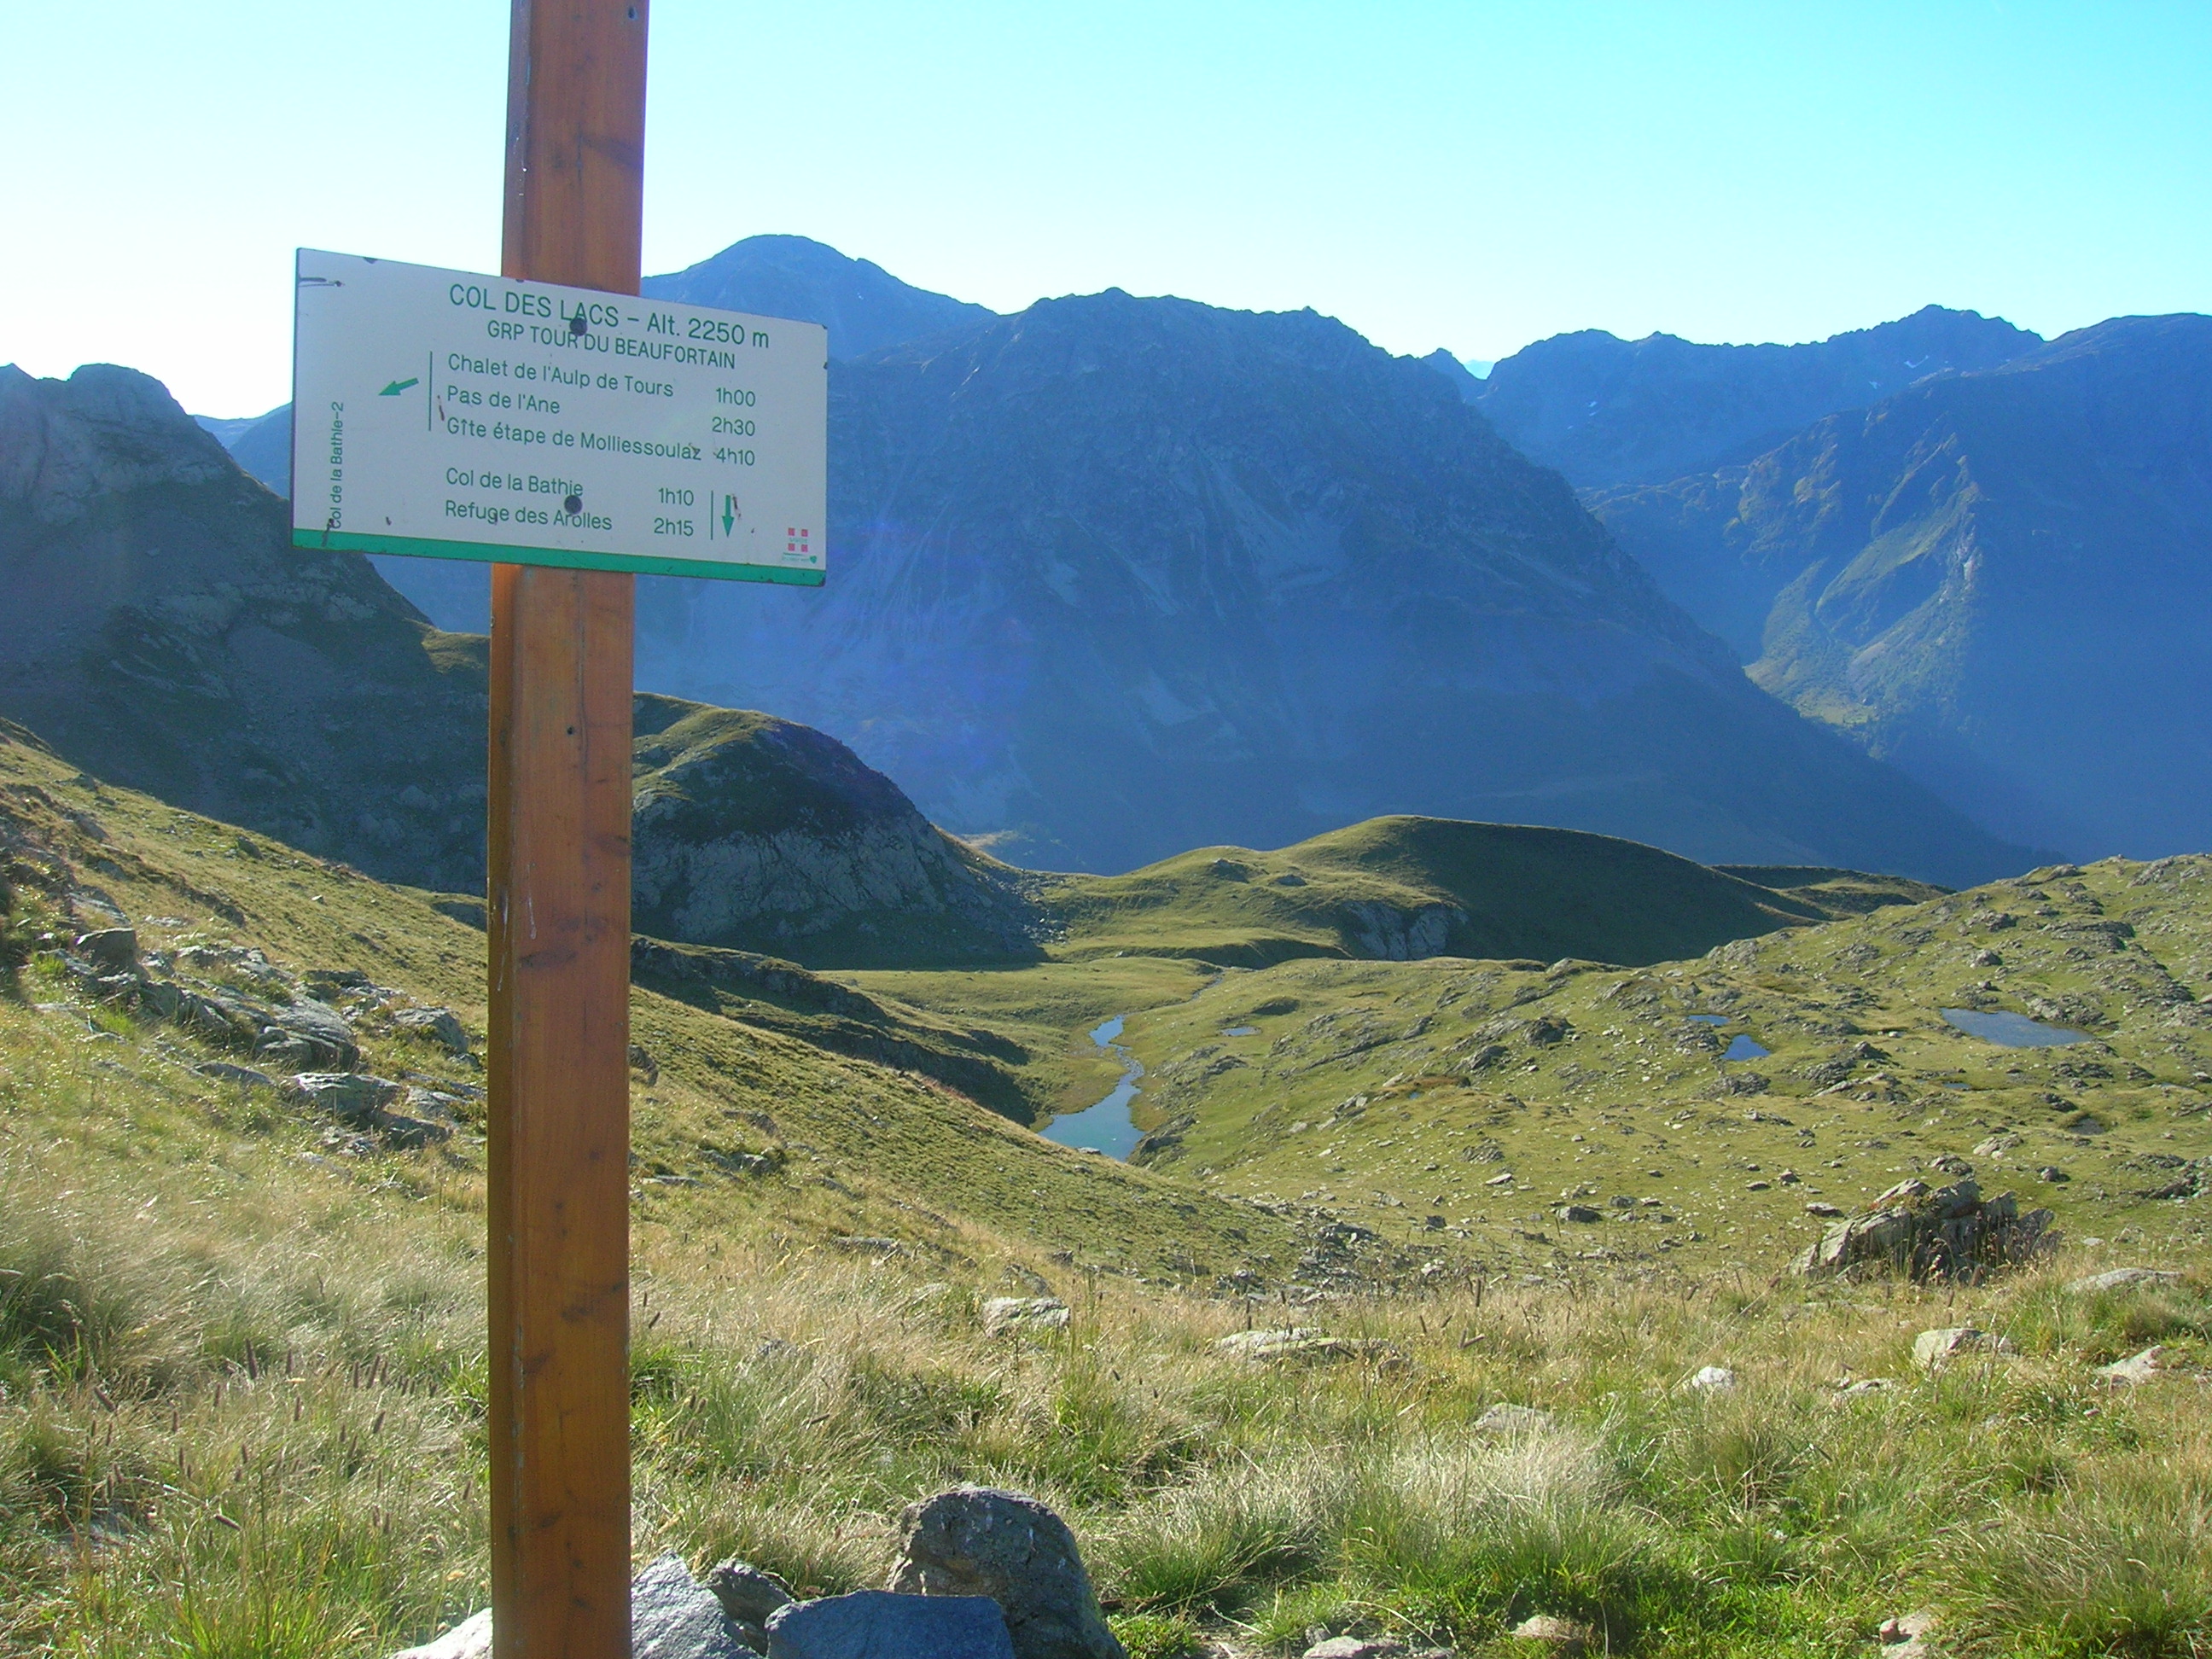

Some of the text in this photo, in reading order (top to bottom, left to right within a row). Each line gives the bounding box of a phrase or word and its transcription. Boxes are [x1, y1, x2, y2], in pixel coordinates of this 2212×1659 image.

[450, 283, 496, 311] COL
[505, 291, 551, 317] DES
[560, 300, 619, 327] LACS
[647, 312, 680, 337] Alt.
[688, 317, 745, 345] 2250
[753, 331, 770, 348] m
[487, 320, 736, 370] GRP TOUR DU BEAUFORTAIN
[448, 353, 674, 397] Chalet de l'Aulp de Tours
[447, 386, 561, 414] Pas de l'Ane
[715, 387, 756, 407] 1h00
[712, 416, 756, 437] 2h30
[447, 417, 701, 461] Gîte étape de Molliessoulaz
[716, 448, 756, 466] 4h10
[330, 469, 342, 481] la
[446, 467, 584, 497] Col de la Bathie
[330, 485, 342, 503] de
[658, 487, 694, 506] 1h10
[329, 507, 342, 529] Col
[445, 499, 613, 530] Refuge des Arolles
[654, 517, 694, 536] 2h15
